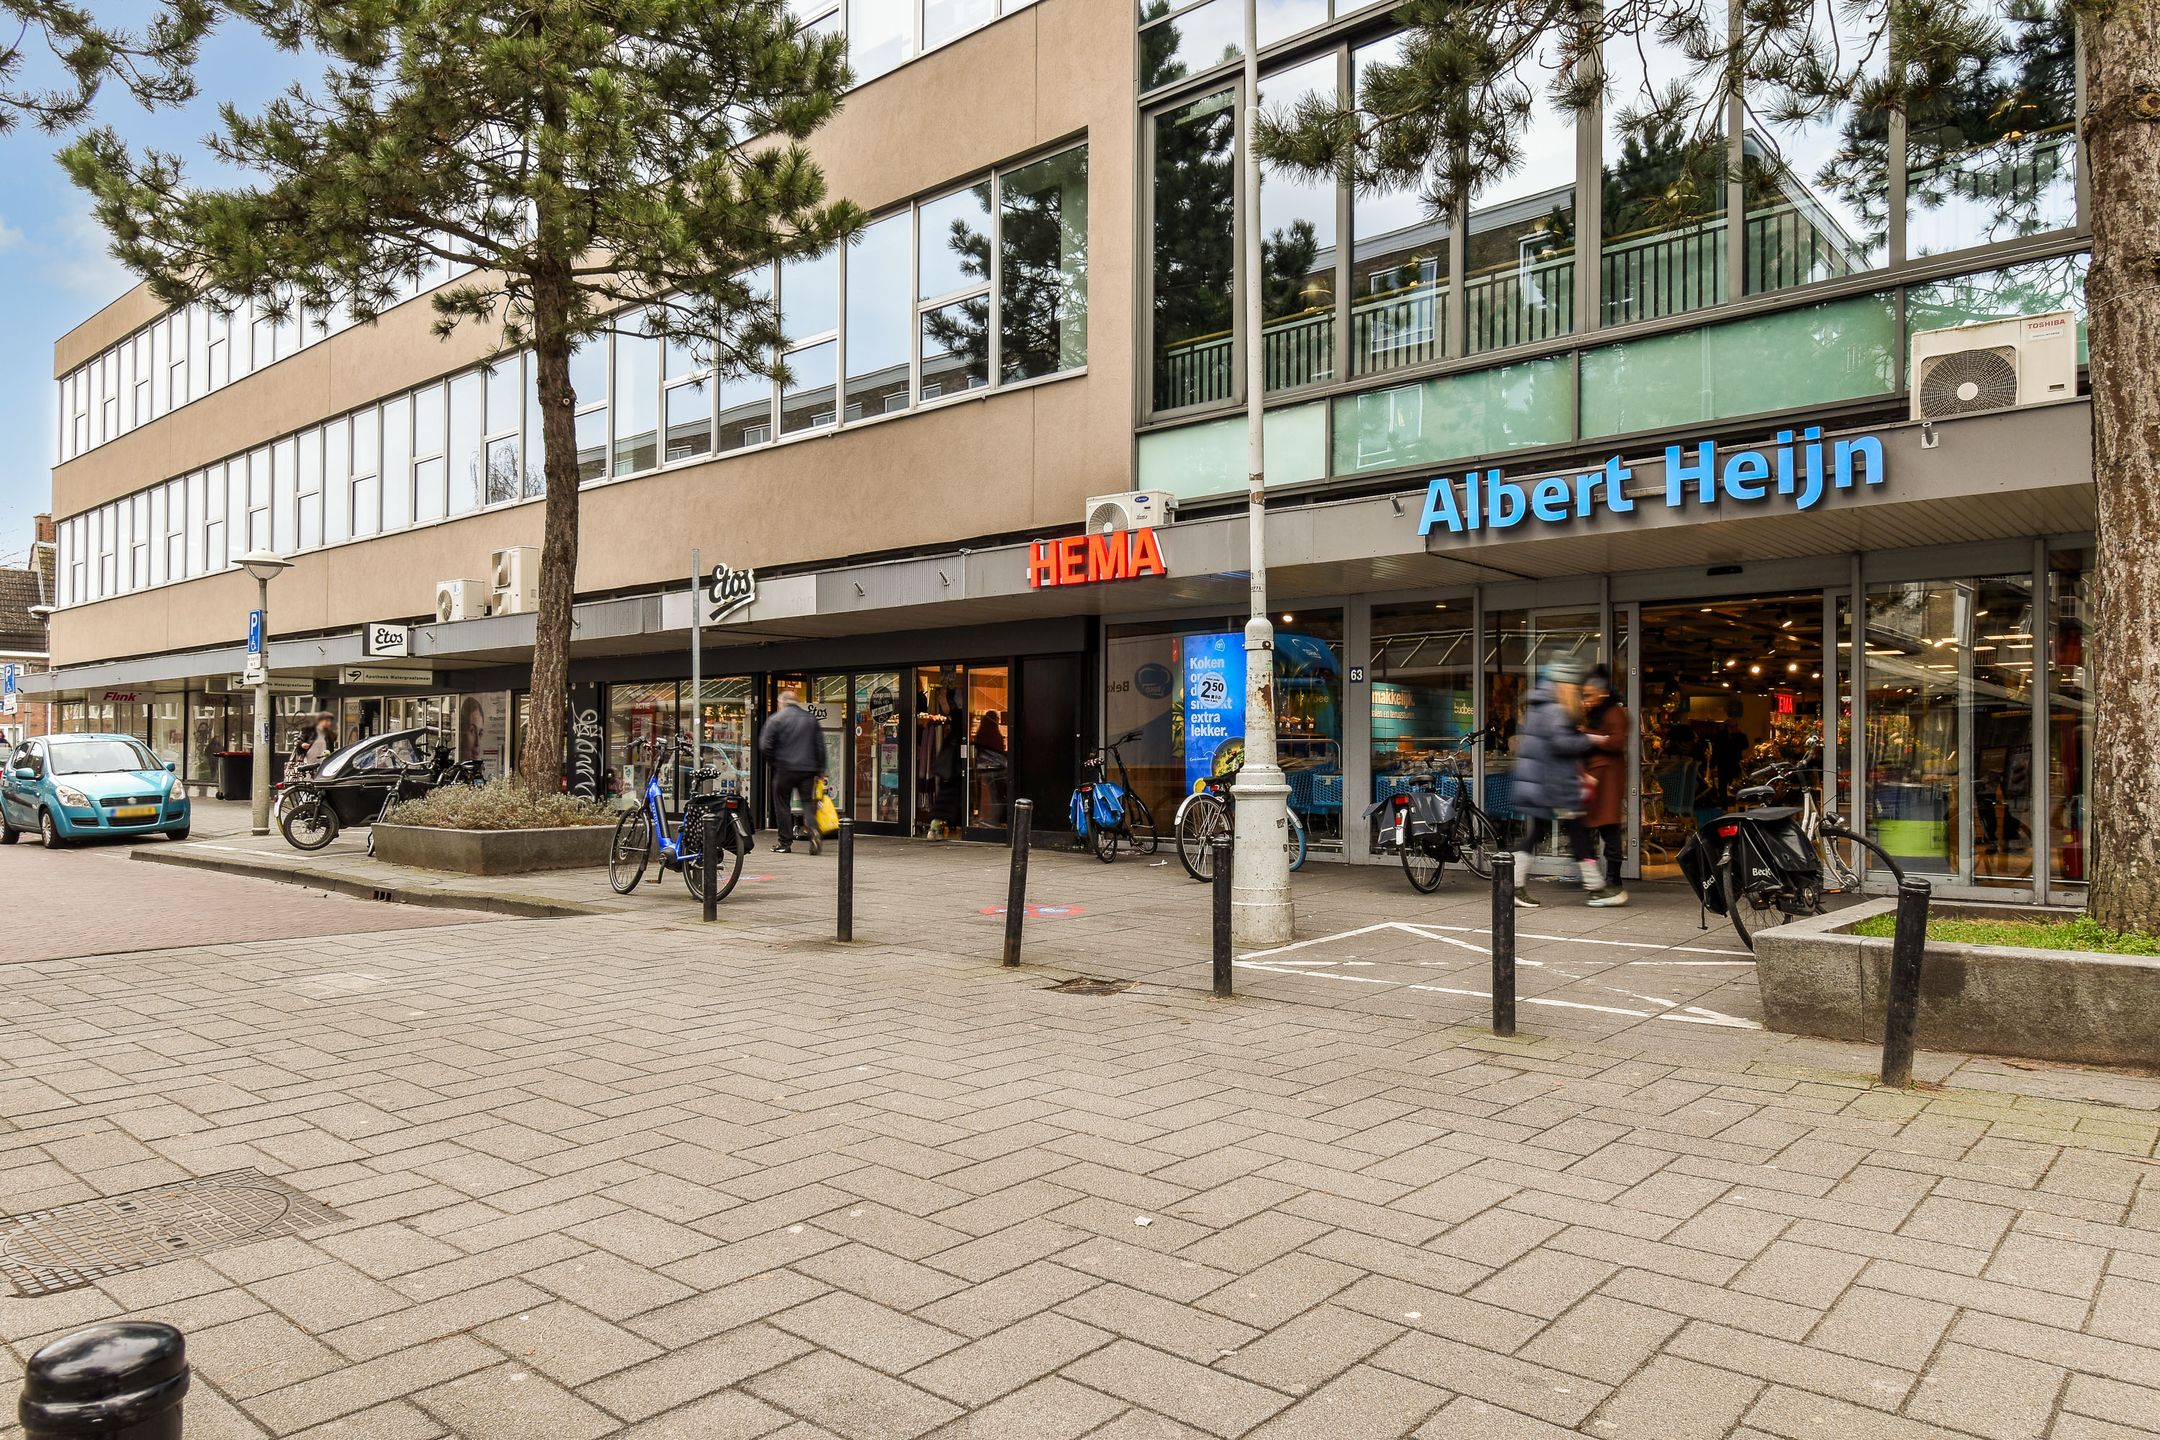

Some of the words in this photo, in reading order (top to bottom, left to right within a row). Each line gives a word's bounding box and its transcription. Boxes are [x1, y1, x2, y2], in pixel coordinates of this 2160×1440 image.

[2027, 319, 2066, 329] TOSHIBA
[1417, 455, 1634, 536] Albert
[1665, 426, 1886, 510] Heijn
[1029, 527, 1166, 588] HEMA
[708, 563, 755, 605] Etos
[250, 613, 258, 636] P
[375, 628, 403, 645] Etos
[1190, 656, 1225, 669] Koken
[1350, 669, 1363, 681] 63
[103, 691, 137, 702] Flink
[807, 704, 828, 718] Etos
[1191, 711, 1221, 724] extra
[1191, 724, 1229, 737] lekker.
